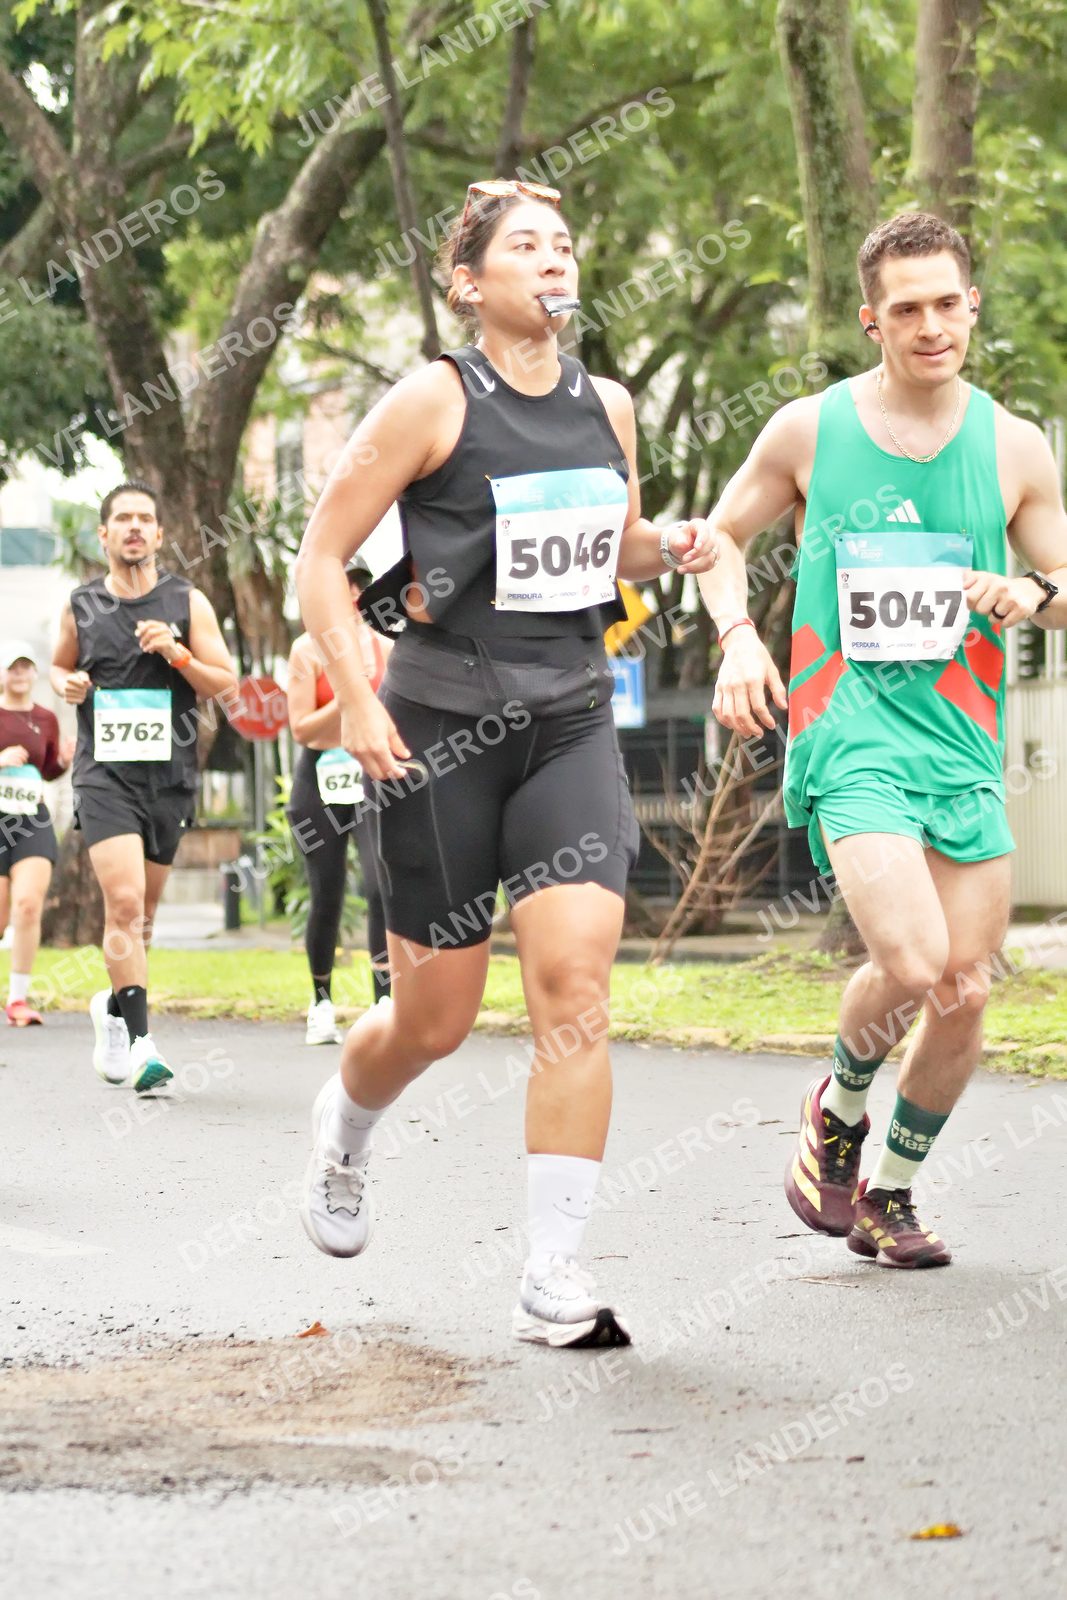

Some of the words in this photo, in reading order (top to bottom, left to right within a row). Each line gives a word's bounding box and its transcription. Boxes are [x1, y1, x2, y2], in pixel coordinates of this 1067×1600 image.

[508, 529, 615, 580] 5046
[507, 592, 543, 600] PERDURA
[849, 590, 962, 630] 5047
[852, 641, 880, 649] PERDURA
[101, 722, 165, 743] 3762
[0, 785, 36, 802] 866
